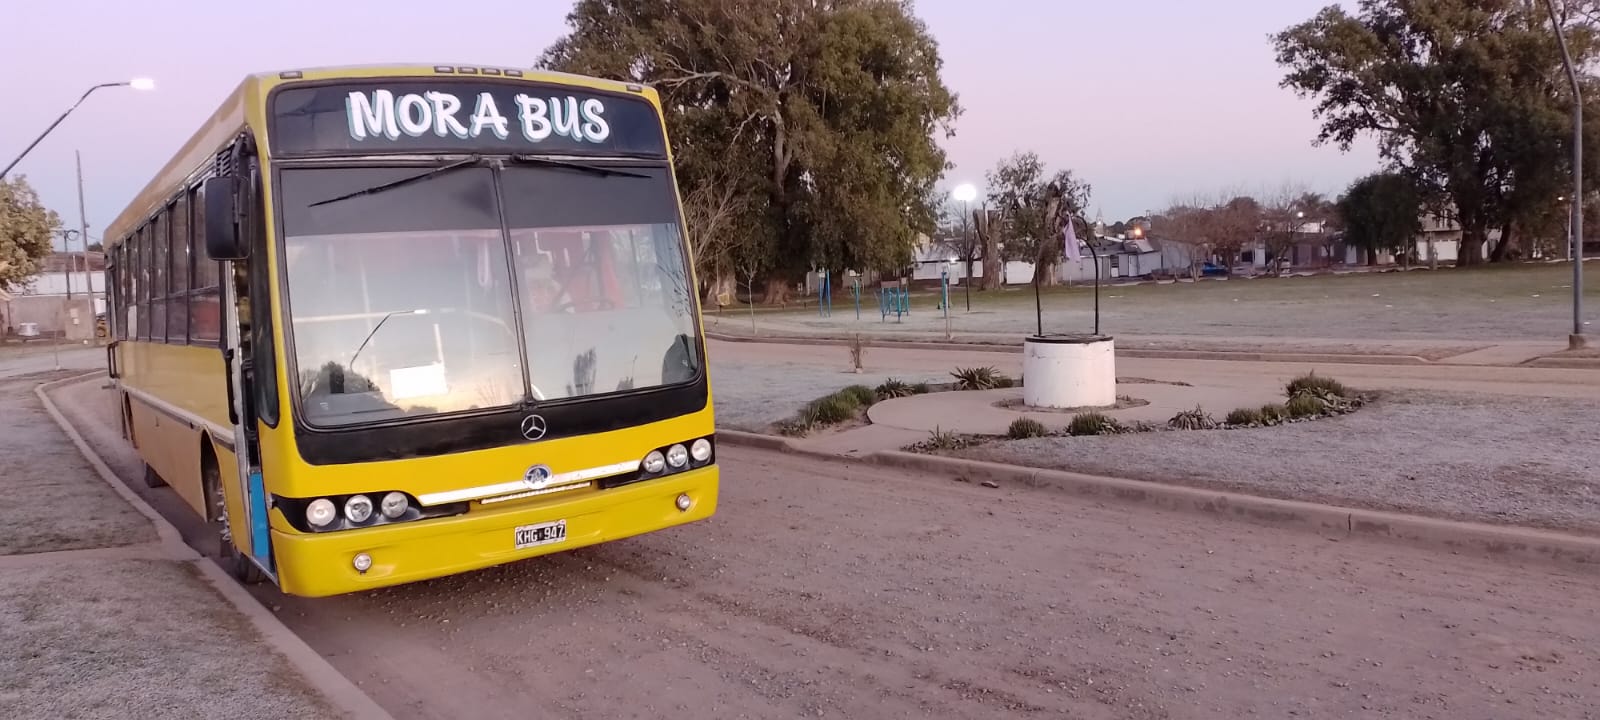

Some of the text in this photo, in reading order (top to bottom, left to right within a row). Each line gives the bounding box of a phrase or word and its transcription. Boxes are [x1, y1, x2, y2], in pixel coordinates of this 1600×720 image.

[346, 89, 610, 143] MORA BUS
[516, 525, 564, 545] KHG 947
